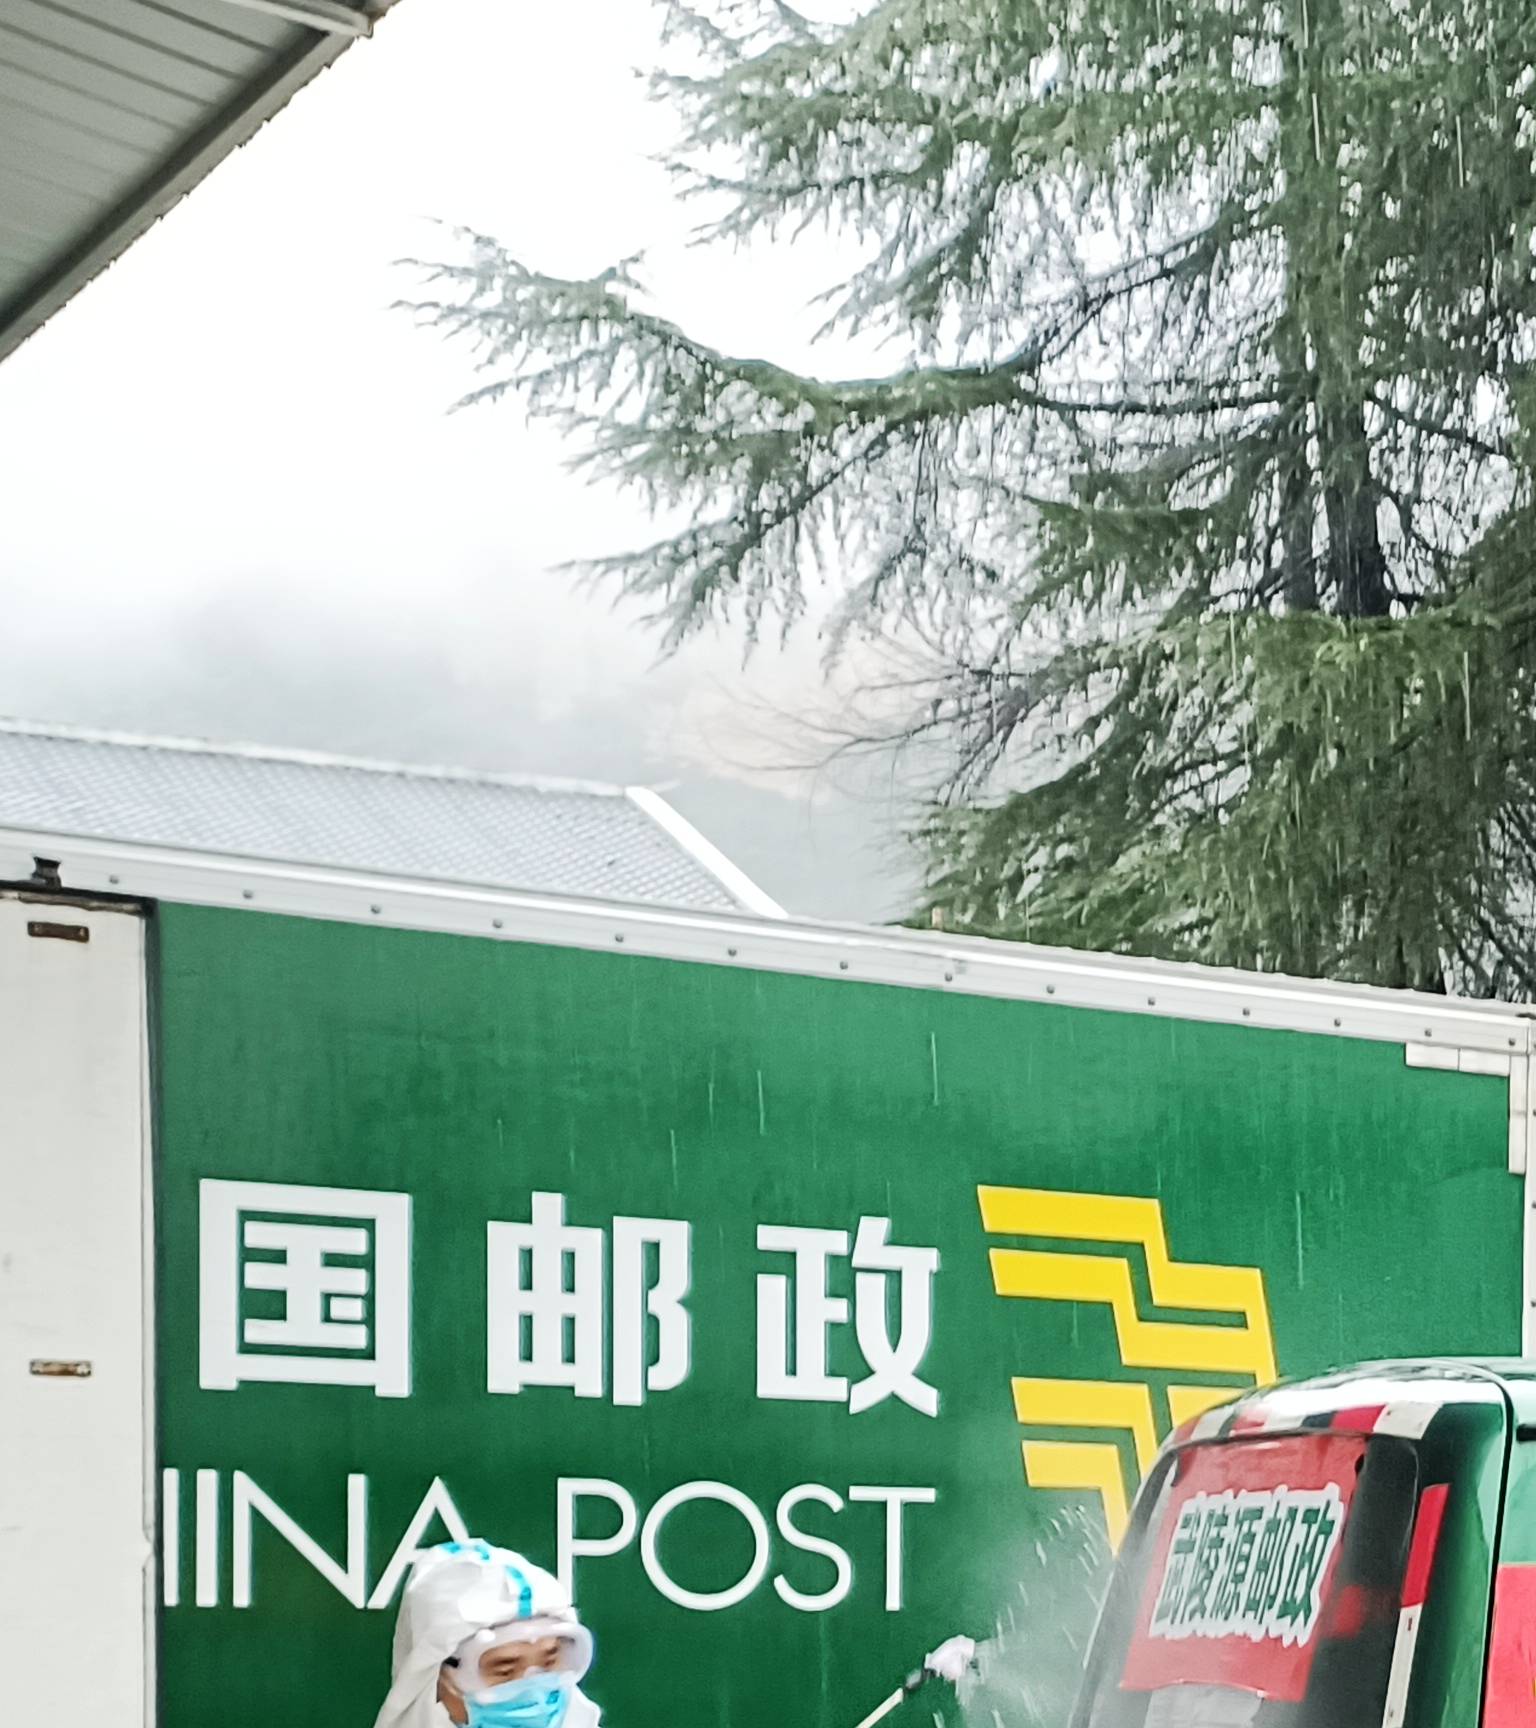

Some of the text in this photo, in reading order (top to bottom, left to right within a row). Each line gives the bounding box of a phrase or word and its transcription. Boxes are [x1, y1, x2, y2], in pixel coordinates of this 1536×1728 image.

[200, 1178, 940, 1418] 国邮政
[556, 1476, 936, 1612] POST
[1153, 1497, 1338, 1628] 武陵源邮政
